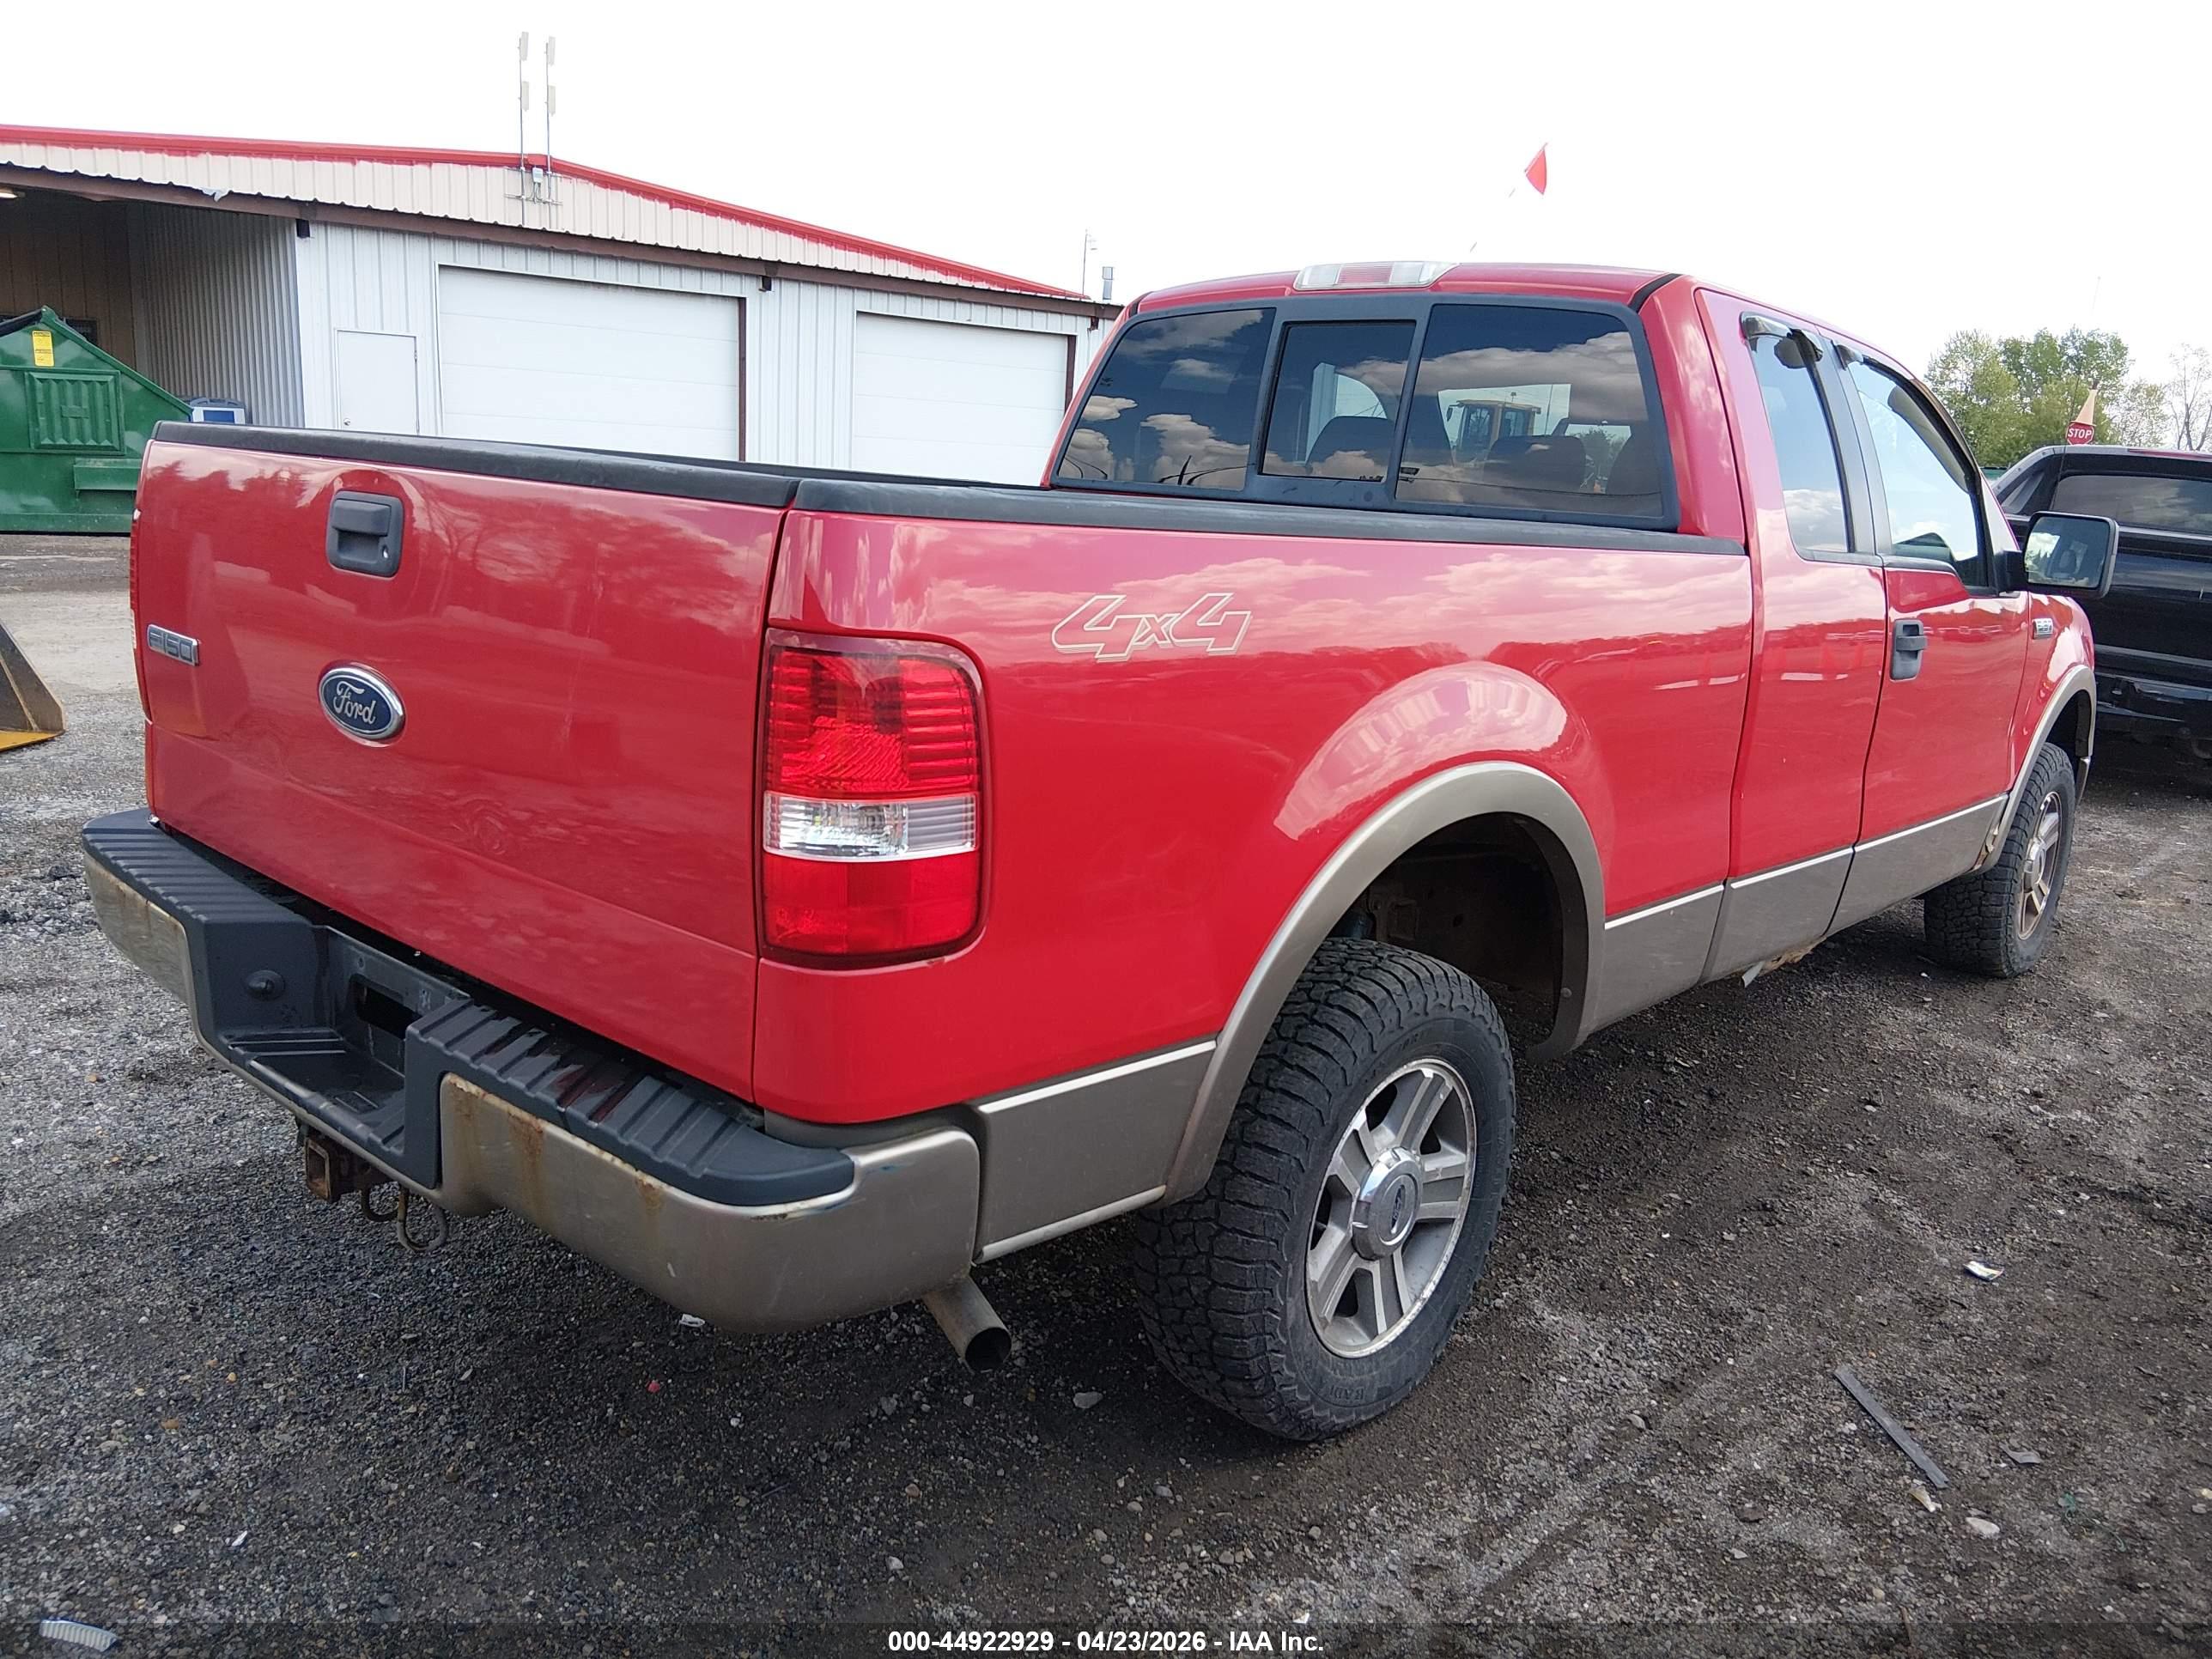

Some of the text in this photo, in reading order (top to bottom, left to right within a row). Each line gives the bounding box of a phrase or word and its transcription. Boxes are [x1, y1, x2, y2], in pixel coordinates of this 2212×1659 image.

[2067, 428, 2092, 439] STOP
[1052, 593, 1252, 663] 4x4
[333, 680, 376, 724] Ford
